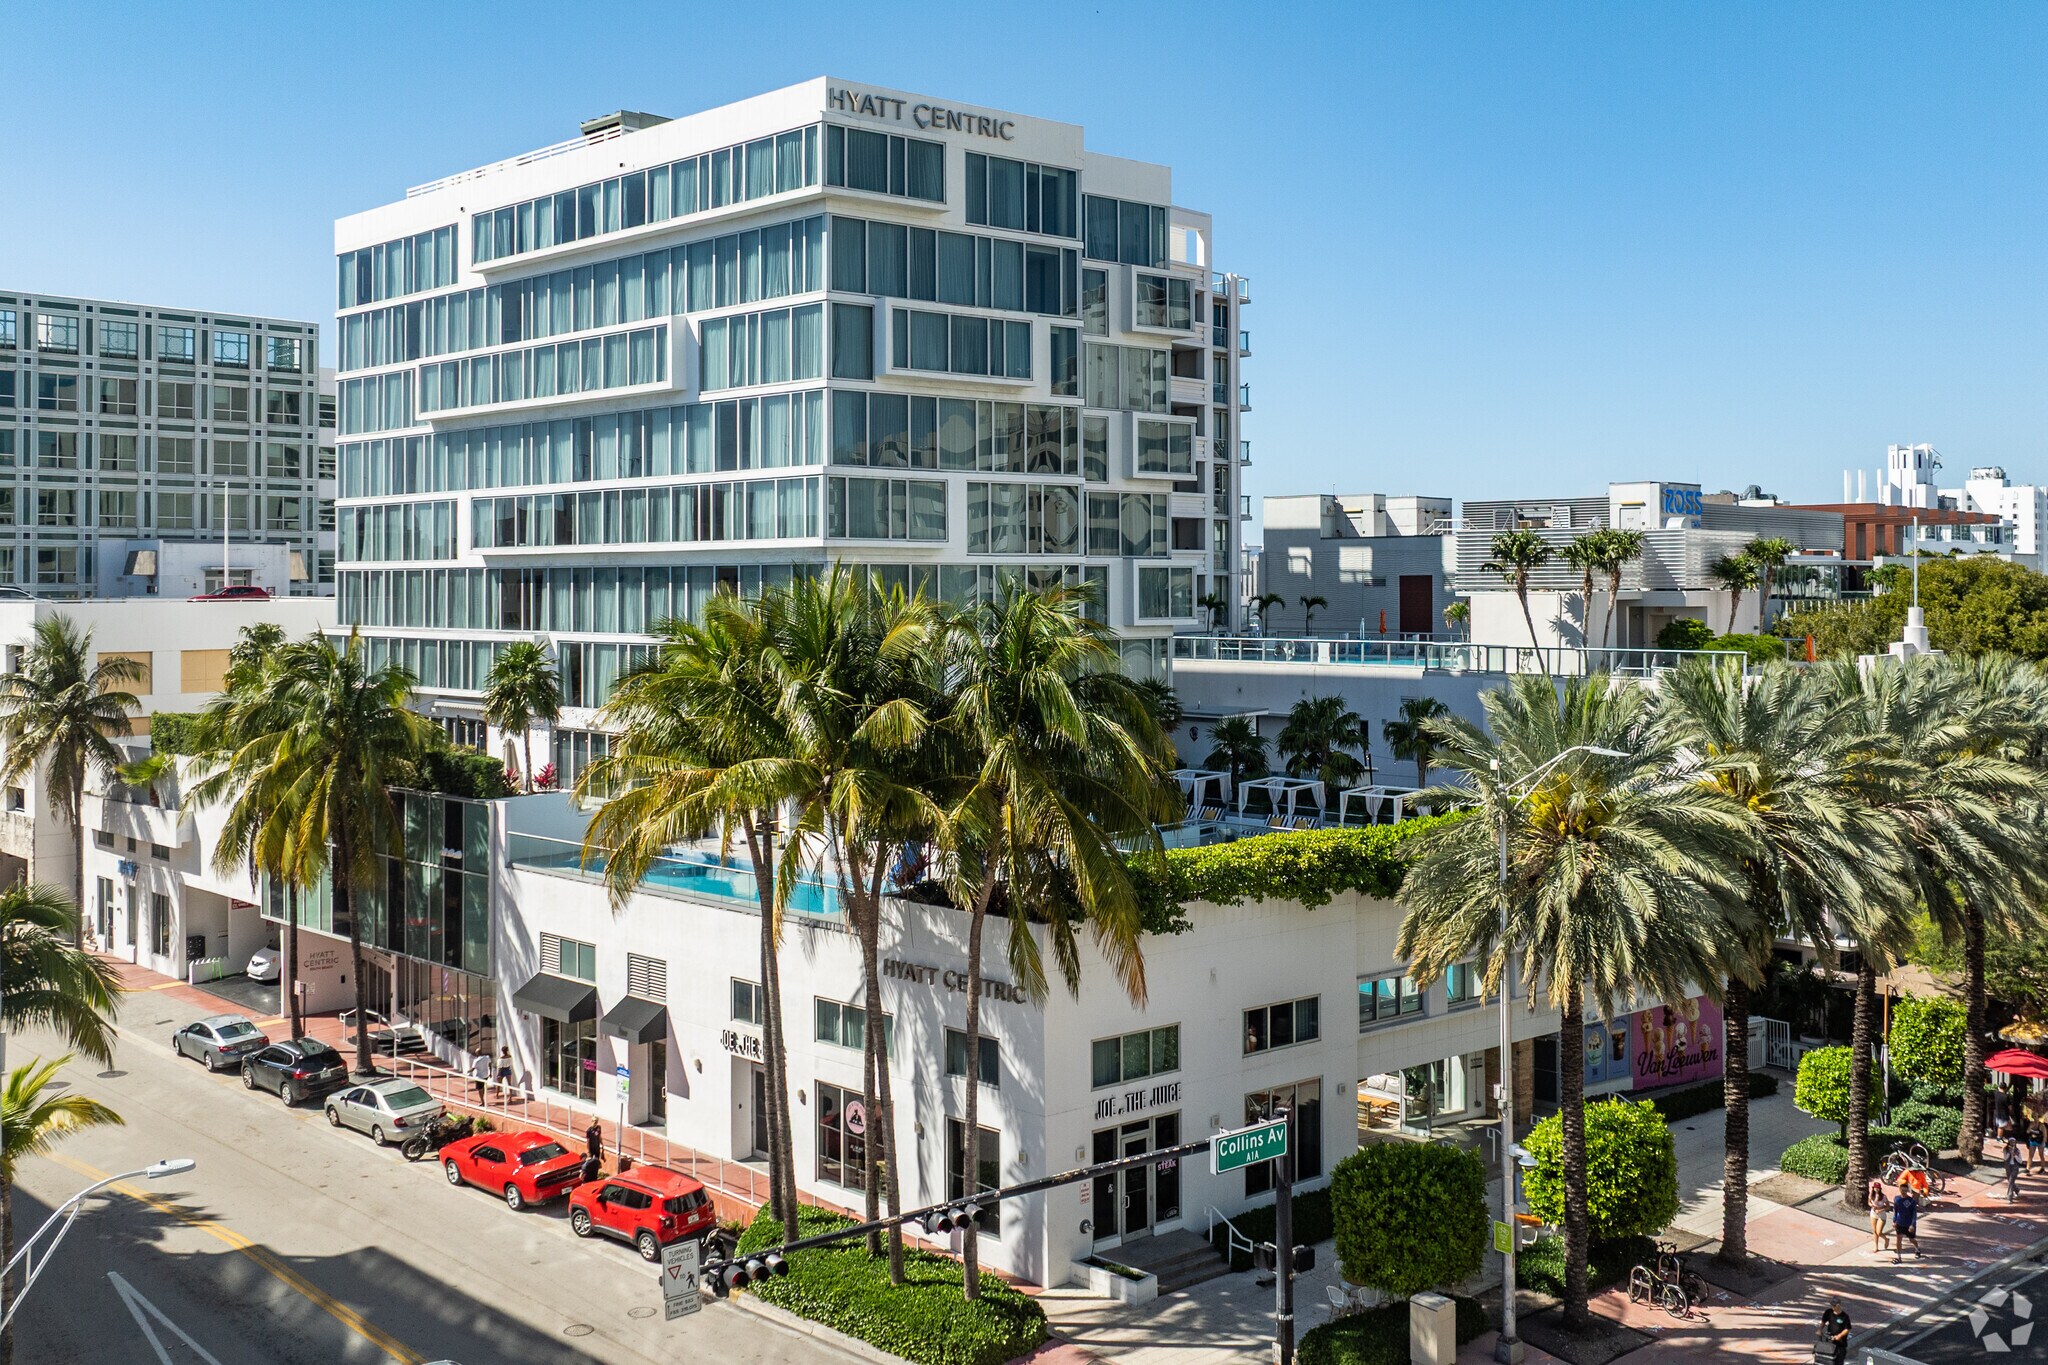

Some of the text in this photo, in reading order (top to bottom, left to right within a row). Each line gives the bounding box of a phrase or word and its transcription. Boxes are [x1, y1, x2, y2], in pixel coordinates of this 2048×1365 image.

[829, 87, 1015, 141] HYATT CENTRIC
[1664, 488, 1702, 515] ROSS
[303, 957, 339, 968] CENTRIC
[310, 950, 335, 959] HYATT
[883, 958, 939, 986] HYATT
[1638, 1046, 1718, 1077] Van Leeuwen
[1095, 1097, 1116, 1120] JOE
[1125, 1090, 1146, 1113] THE
[1150, 1082, 1182, 1107] JUICE
[1220, 1128, 1284, 1157] Collins Av
[667, 1252, 694, 1265] VEHICLES
[669, 1246, 692, 1258] TURNING
